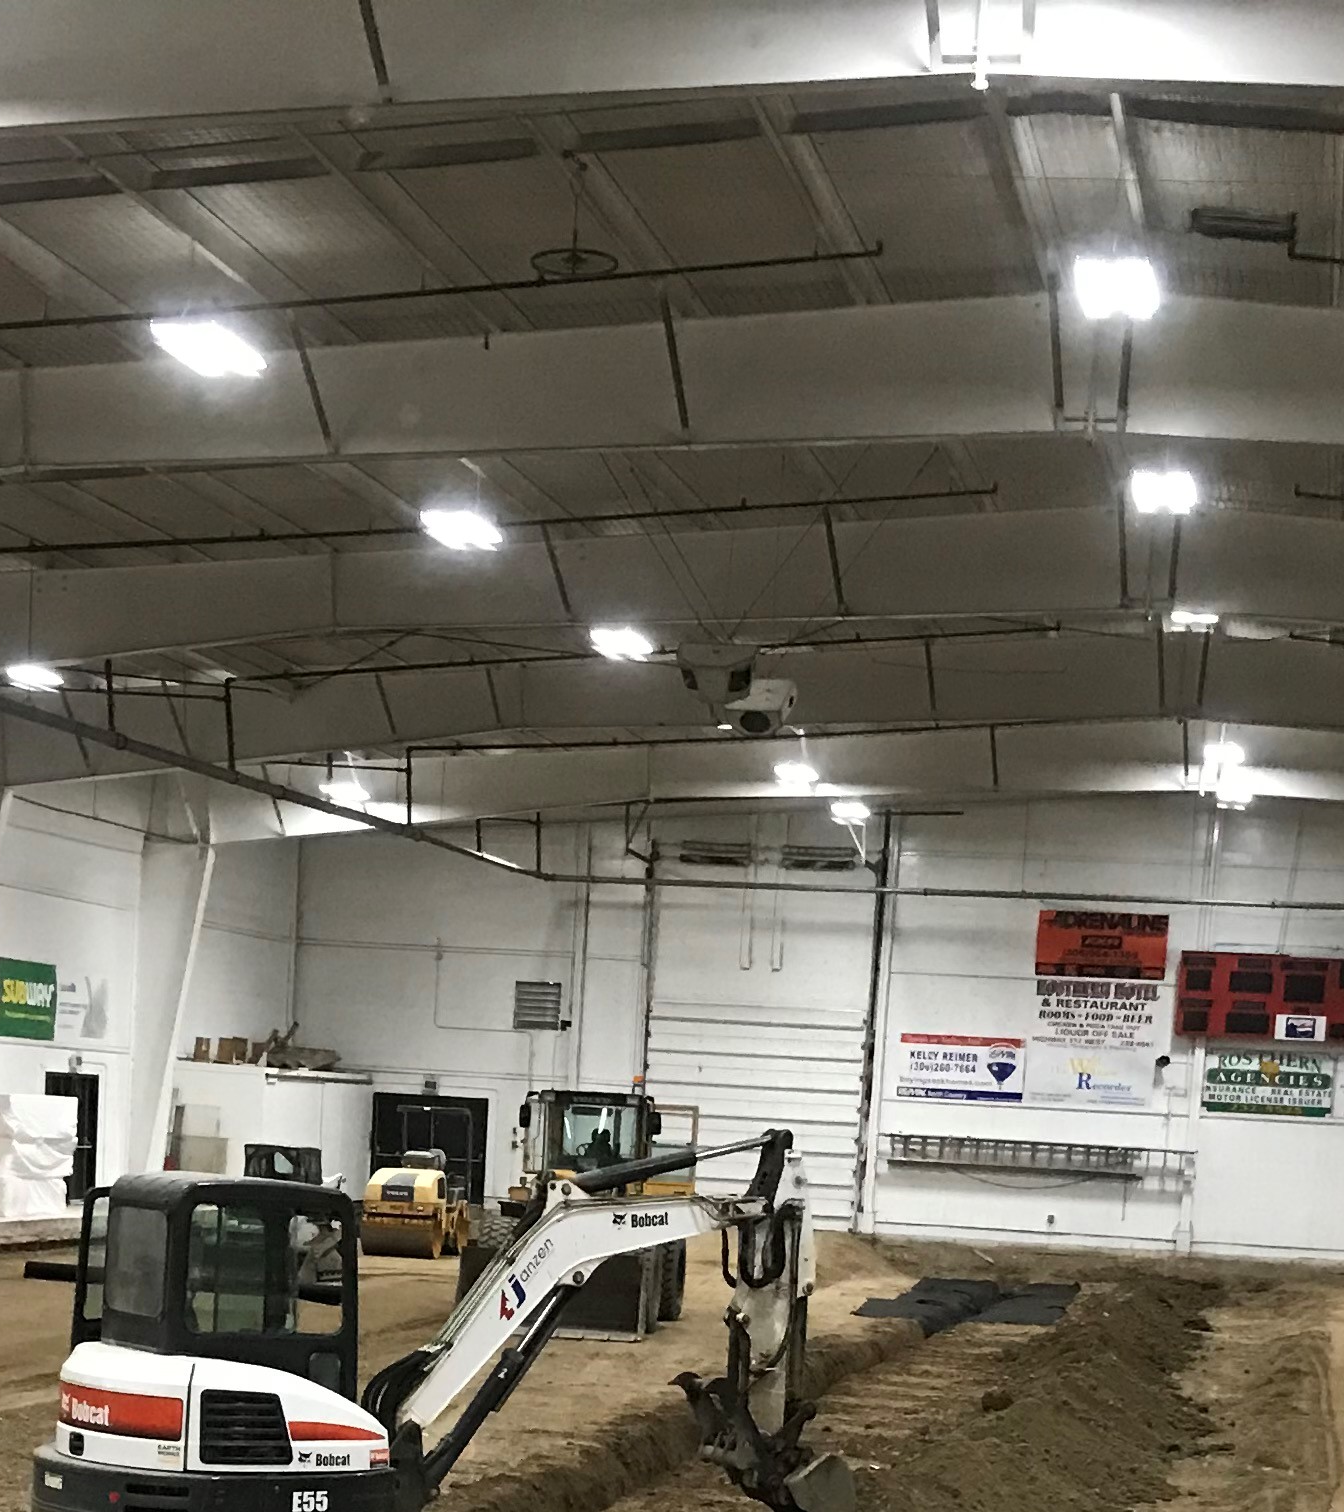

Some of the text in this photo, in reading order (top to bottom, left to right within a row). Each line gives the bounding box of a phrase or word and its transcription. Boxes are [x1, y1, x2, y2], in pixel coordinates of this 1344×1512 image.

[1, 978, 55, 1008] SUBWAY
[1041, 997, 1148, 1012] & RESTAURANT
[1038, 1010, 1153, 1025] ROOMS FOOD BEER
[1055, 1028, 1135, 1040] LIQUOR OFF SALE
[942, 1051, 978, 1063] REIMER
[1075, 1072, 1132, 1093] Recorder
[1216, 1071, 1323, 1086] AGENCIES
[1209, 1093, 1242, 1102] MOTOR
[1288, 1097, 1323, 1106] ISSUER
[1271, 1088, 1294, 1097] REAL
[1299, 1089, 1332, 1099] ESTATE
[630, 1211, 669, 1228] Bobcat
[71, 1397, 111, 1427] Bobcat
[315, 1453, 351, 1468] Bobcat
[291, 1490, 329, 1512] E55
